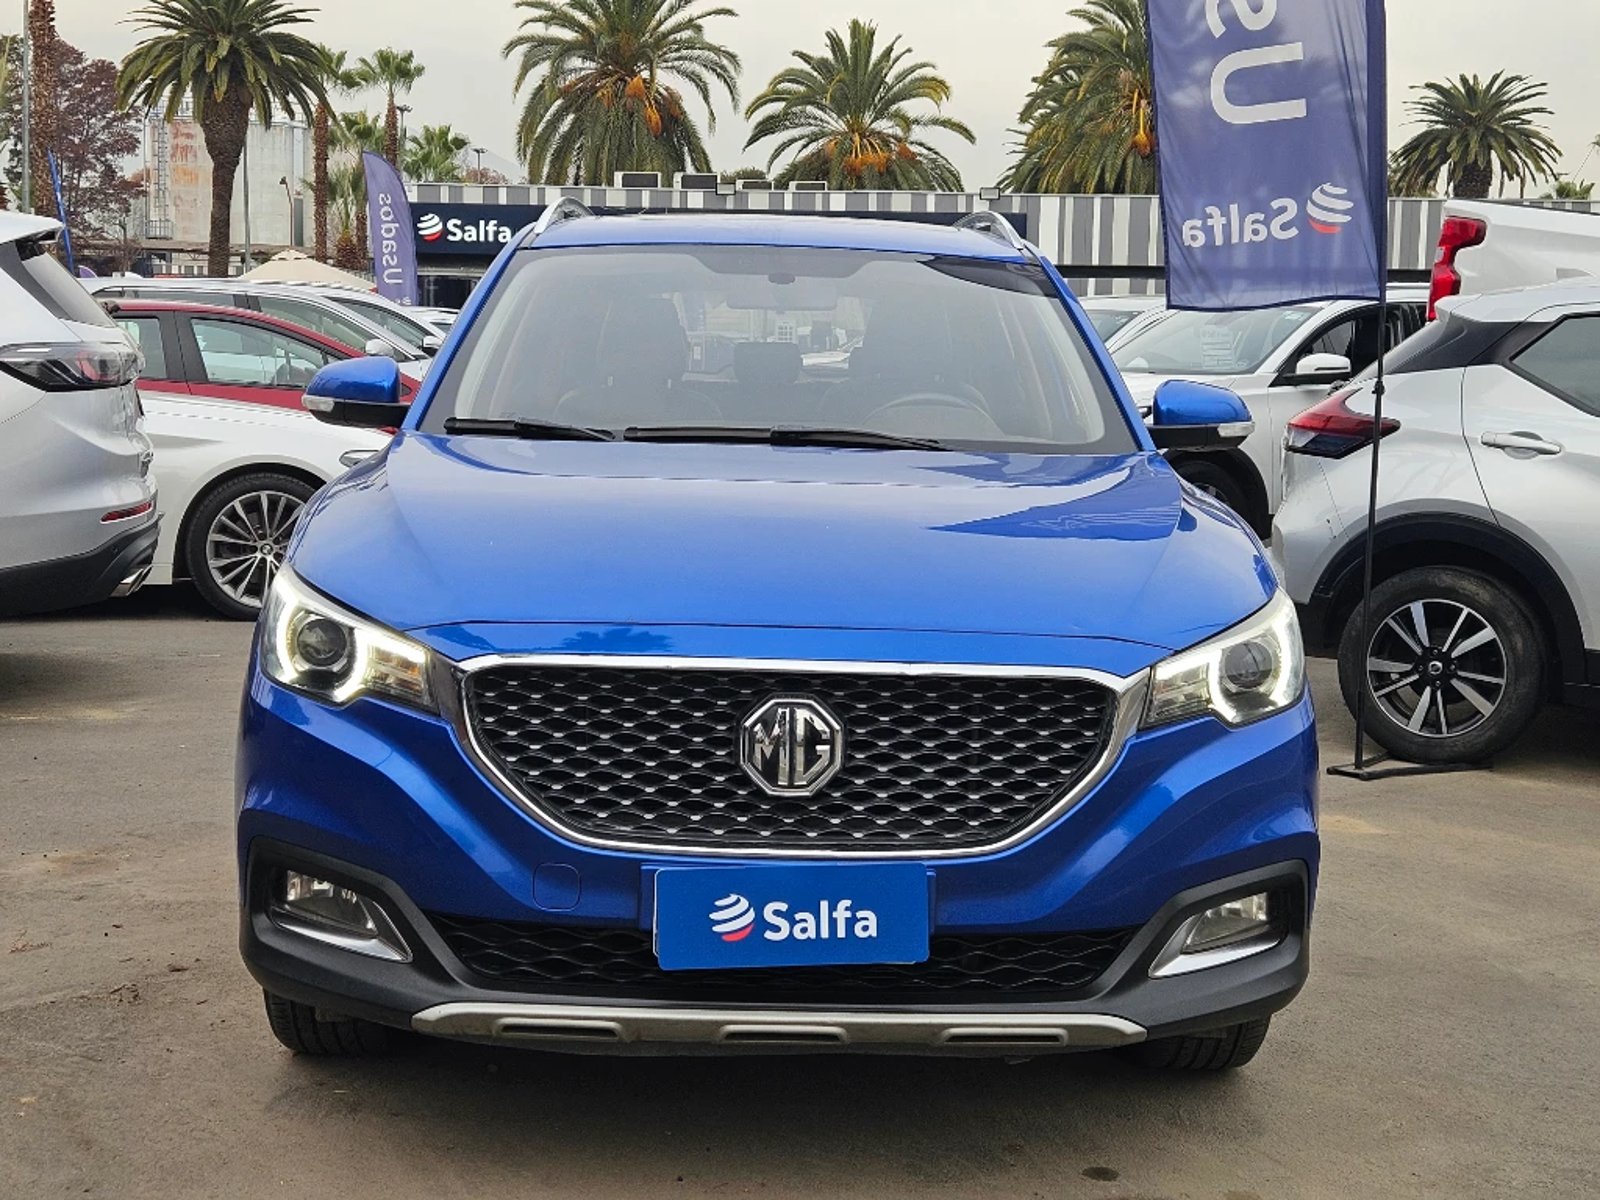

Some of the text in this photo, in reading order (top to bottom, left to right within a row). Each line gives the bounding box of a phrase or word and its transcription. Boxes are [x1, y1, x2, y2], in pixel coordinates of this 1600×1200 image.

[446, 218, 512, 243] Salfa
[753, 706, 831, 785] MG
[763, 899, 878, 942] Salfa
